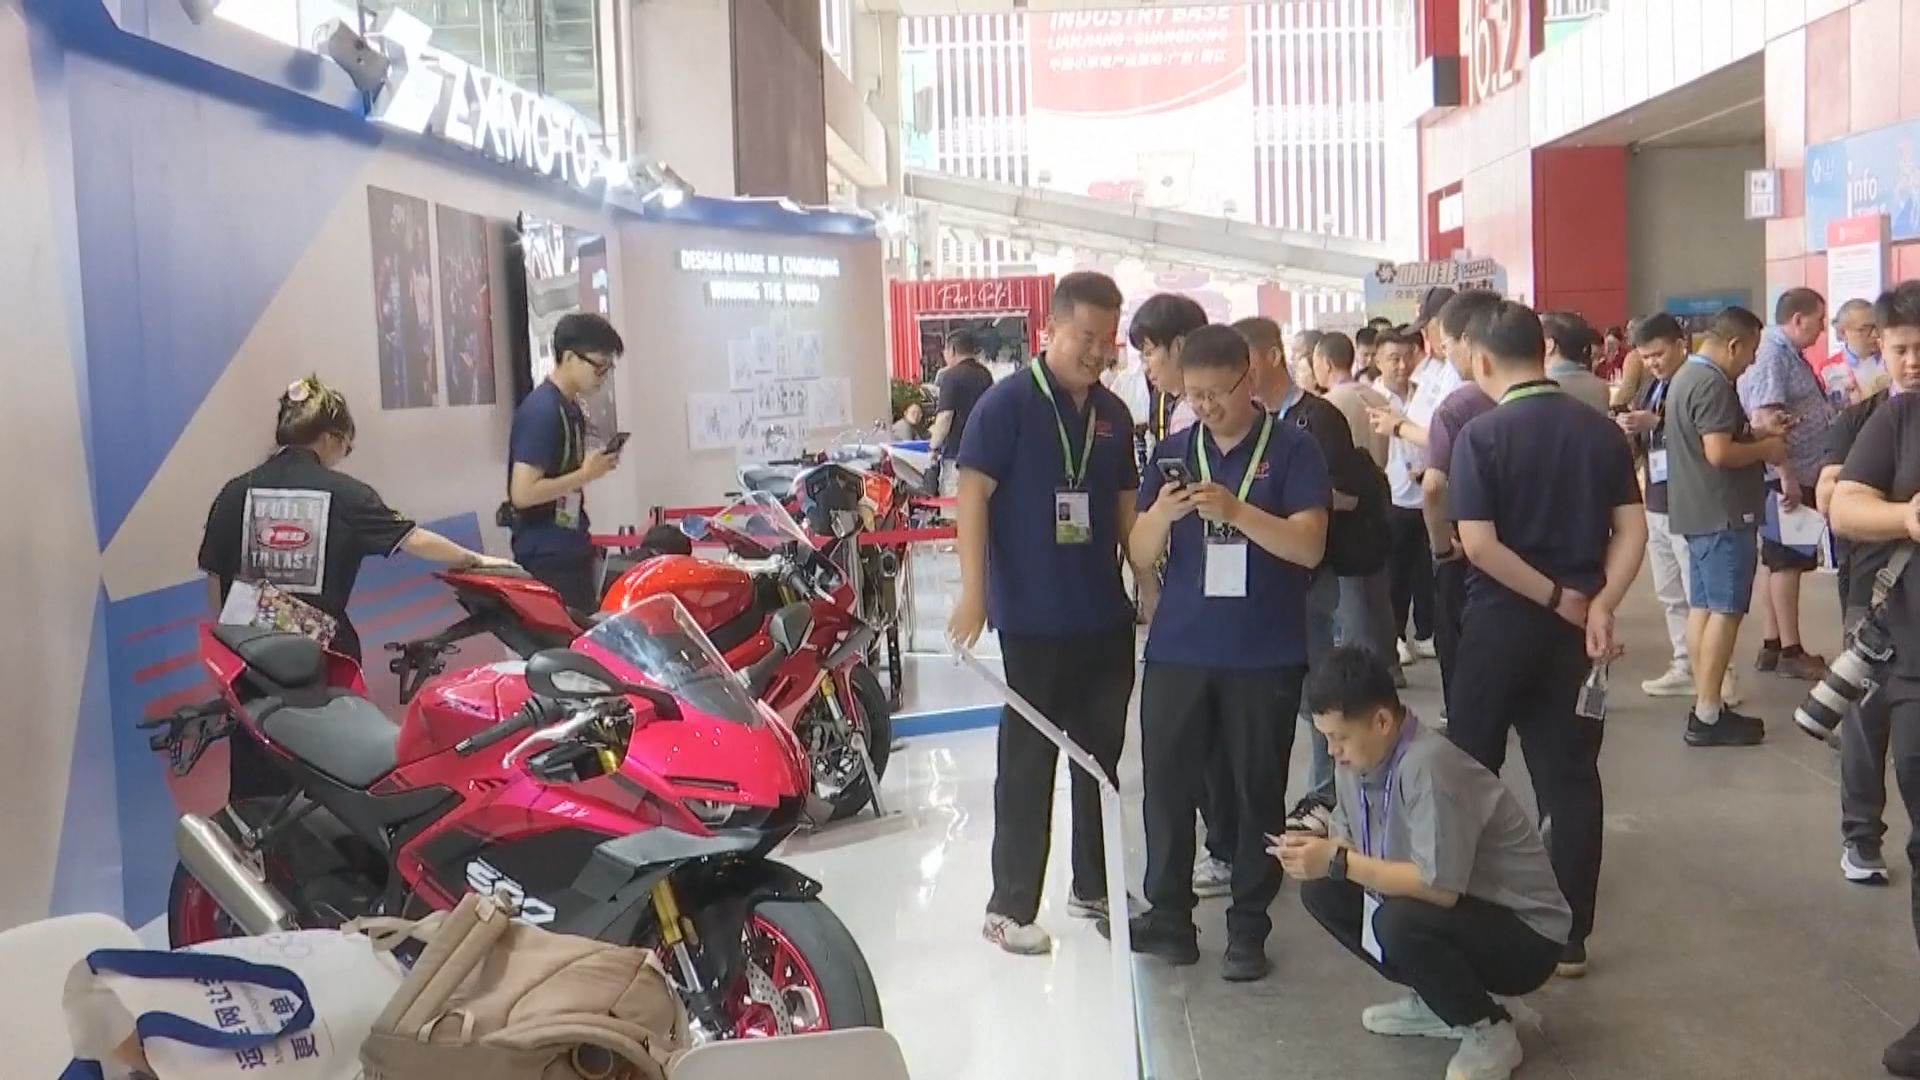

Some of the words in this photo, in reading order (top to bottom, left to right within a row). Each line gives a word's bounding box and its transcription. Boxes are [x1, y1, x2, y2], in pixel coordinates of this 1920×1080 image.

[1050, 9, 1166, 29] INDUSTRY
[1171, 6, 1232, 23] BASE
[273, 551, 315, 570] LAST
